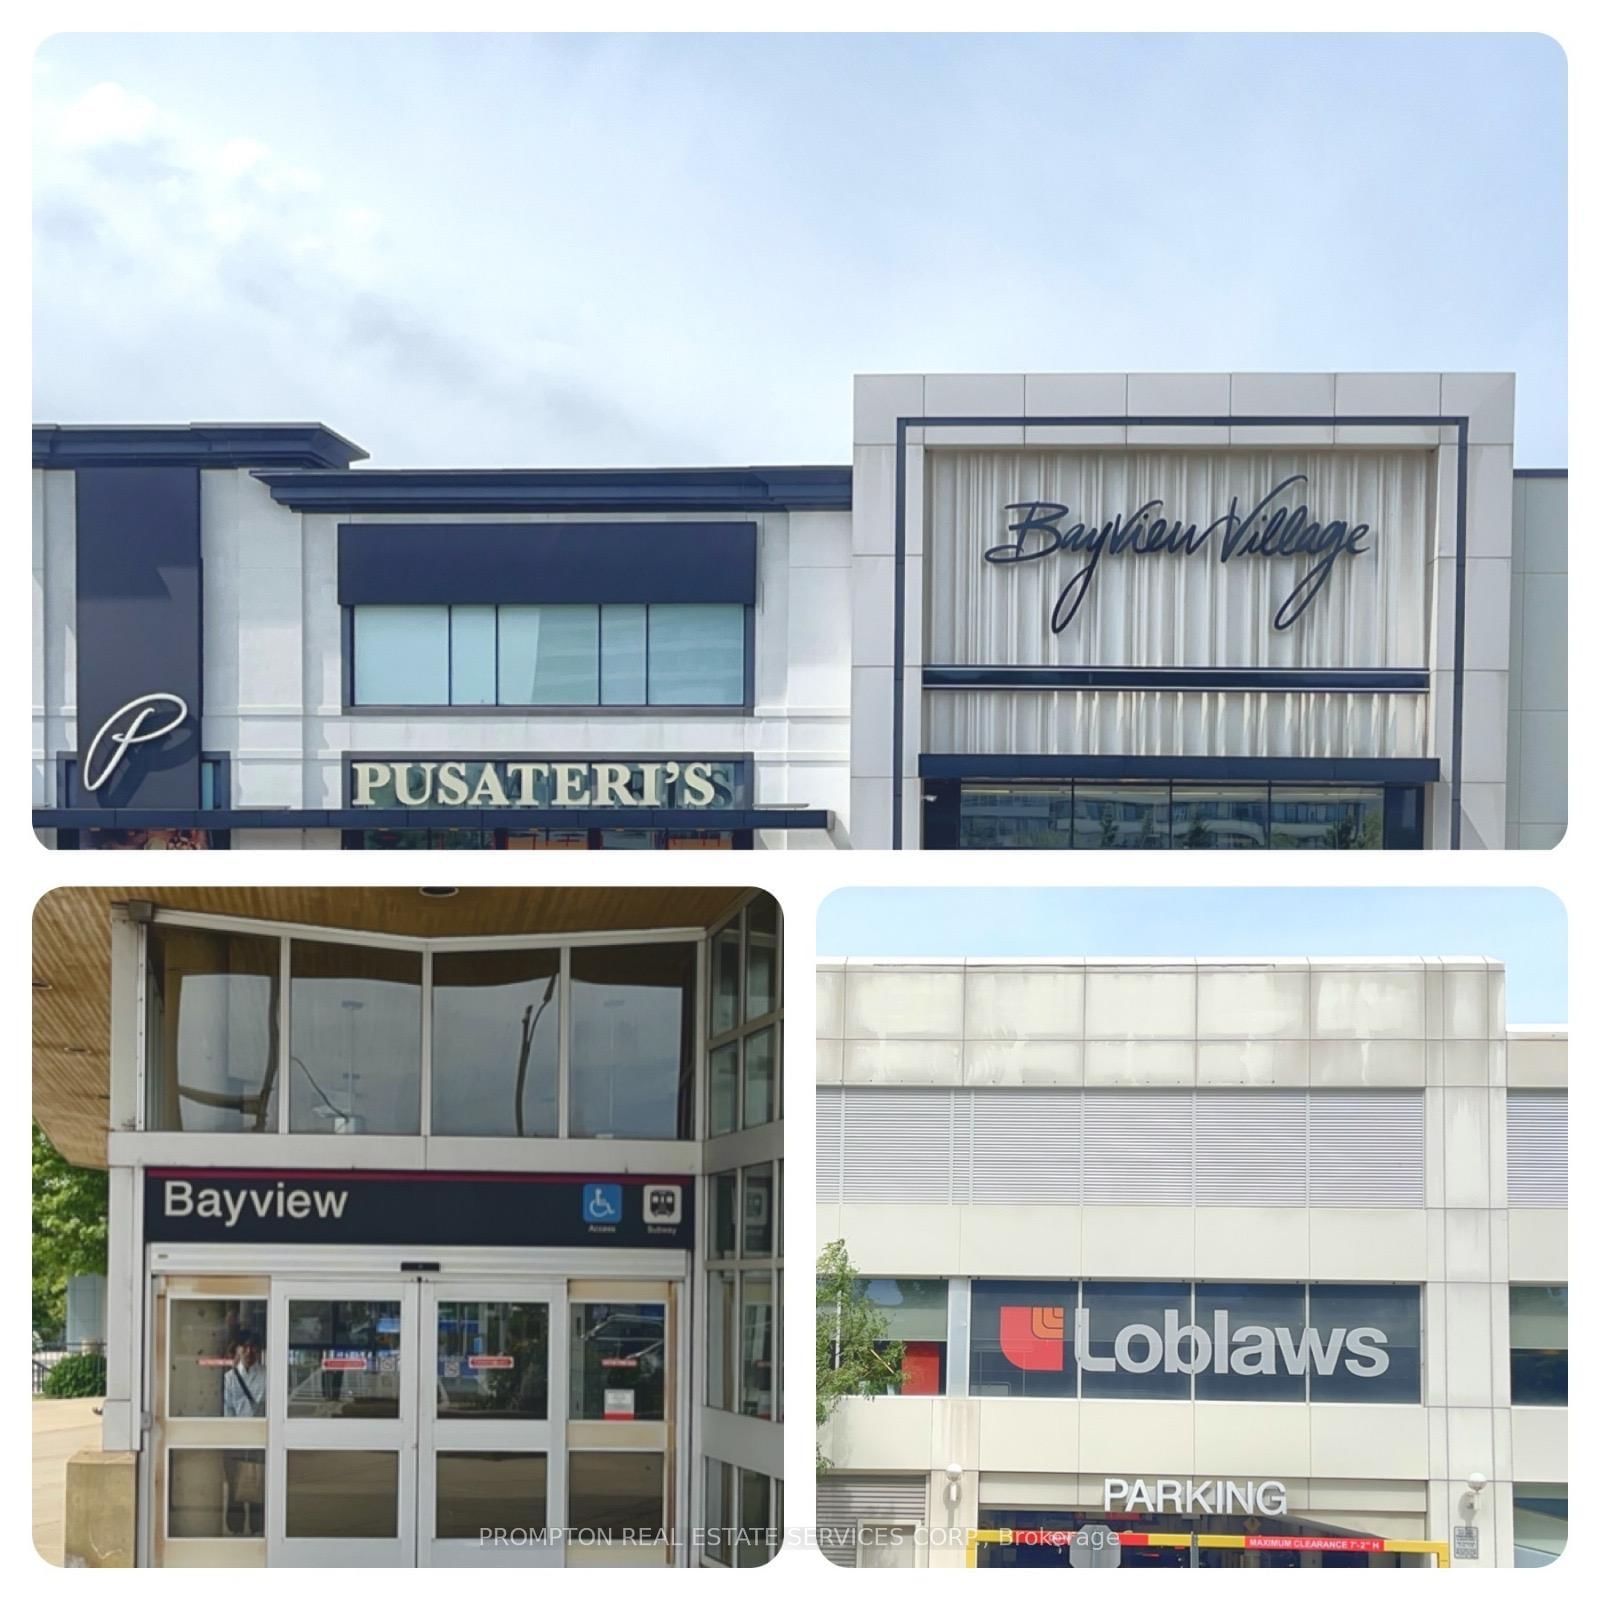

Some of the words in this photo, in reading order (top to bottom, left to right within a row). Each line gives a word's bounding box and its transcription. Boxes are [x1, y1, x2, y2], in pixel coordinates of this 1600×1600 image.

[1204, 475, 1371, 630] Village
[351, 761, 716, 807] PUSATERI'S
[164, 1180, 349, 1228] Bayview
[1074, 1308, 1390, 1378] Loblaws
[1104, 1478, 1288, 1516] PARKING
[1249, 1538, 1291, 1548] MAXIMUM
[1293, 1539, 1348, 1549] CLEARANCE
